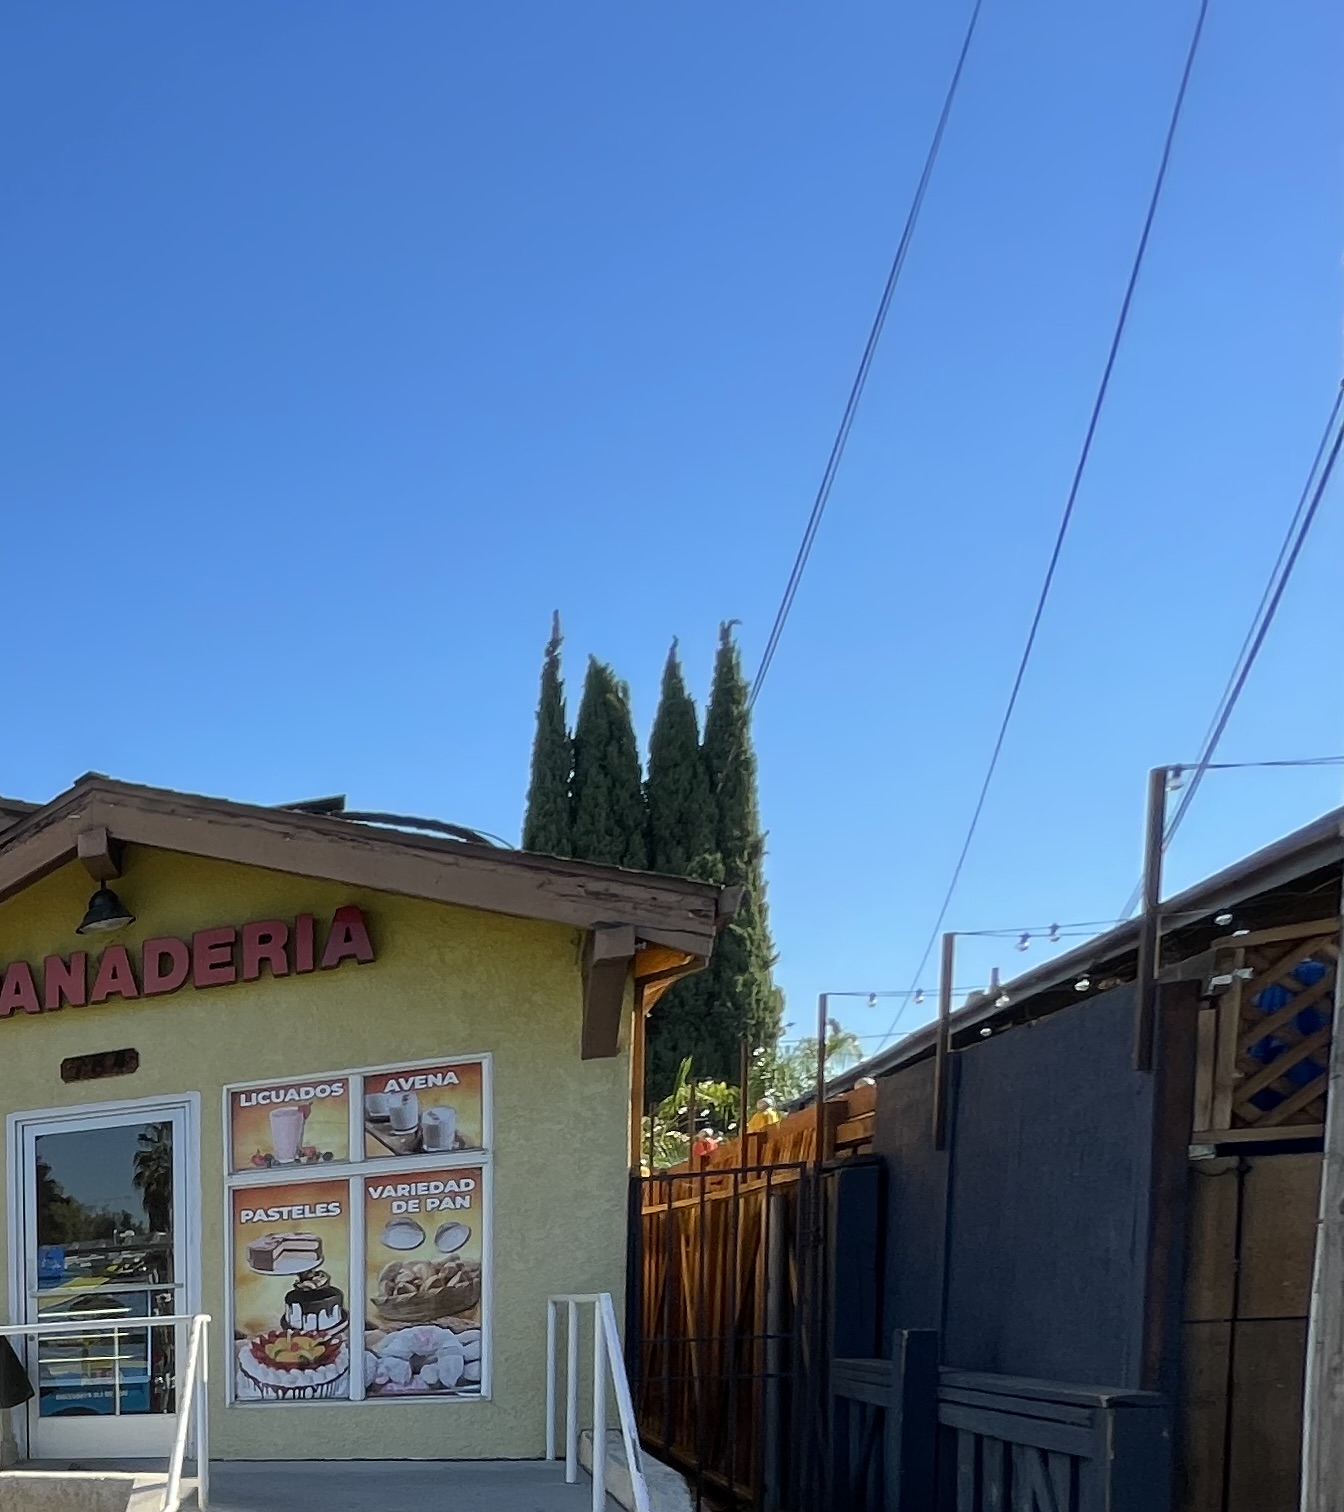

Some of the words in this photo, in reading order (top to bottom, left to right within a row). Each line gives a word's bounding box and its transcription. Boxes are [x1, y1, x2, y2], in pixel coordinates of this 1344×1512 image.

[384, 1071, 459, 1093] AVENA
[240, 1082, 344, 1107] LICUADOS
[368, 1178, 476, 1199] VARIEDAD
[240, 1202, 341, 1223] PASTELES
[392, 1198, 421, 1214] DE
[426, 1195, 471, 1211] PAN
